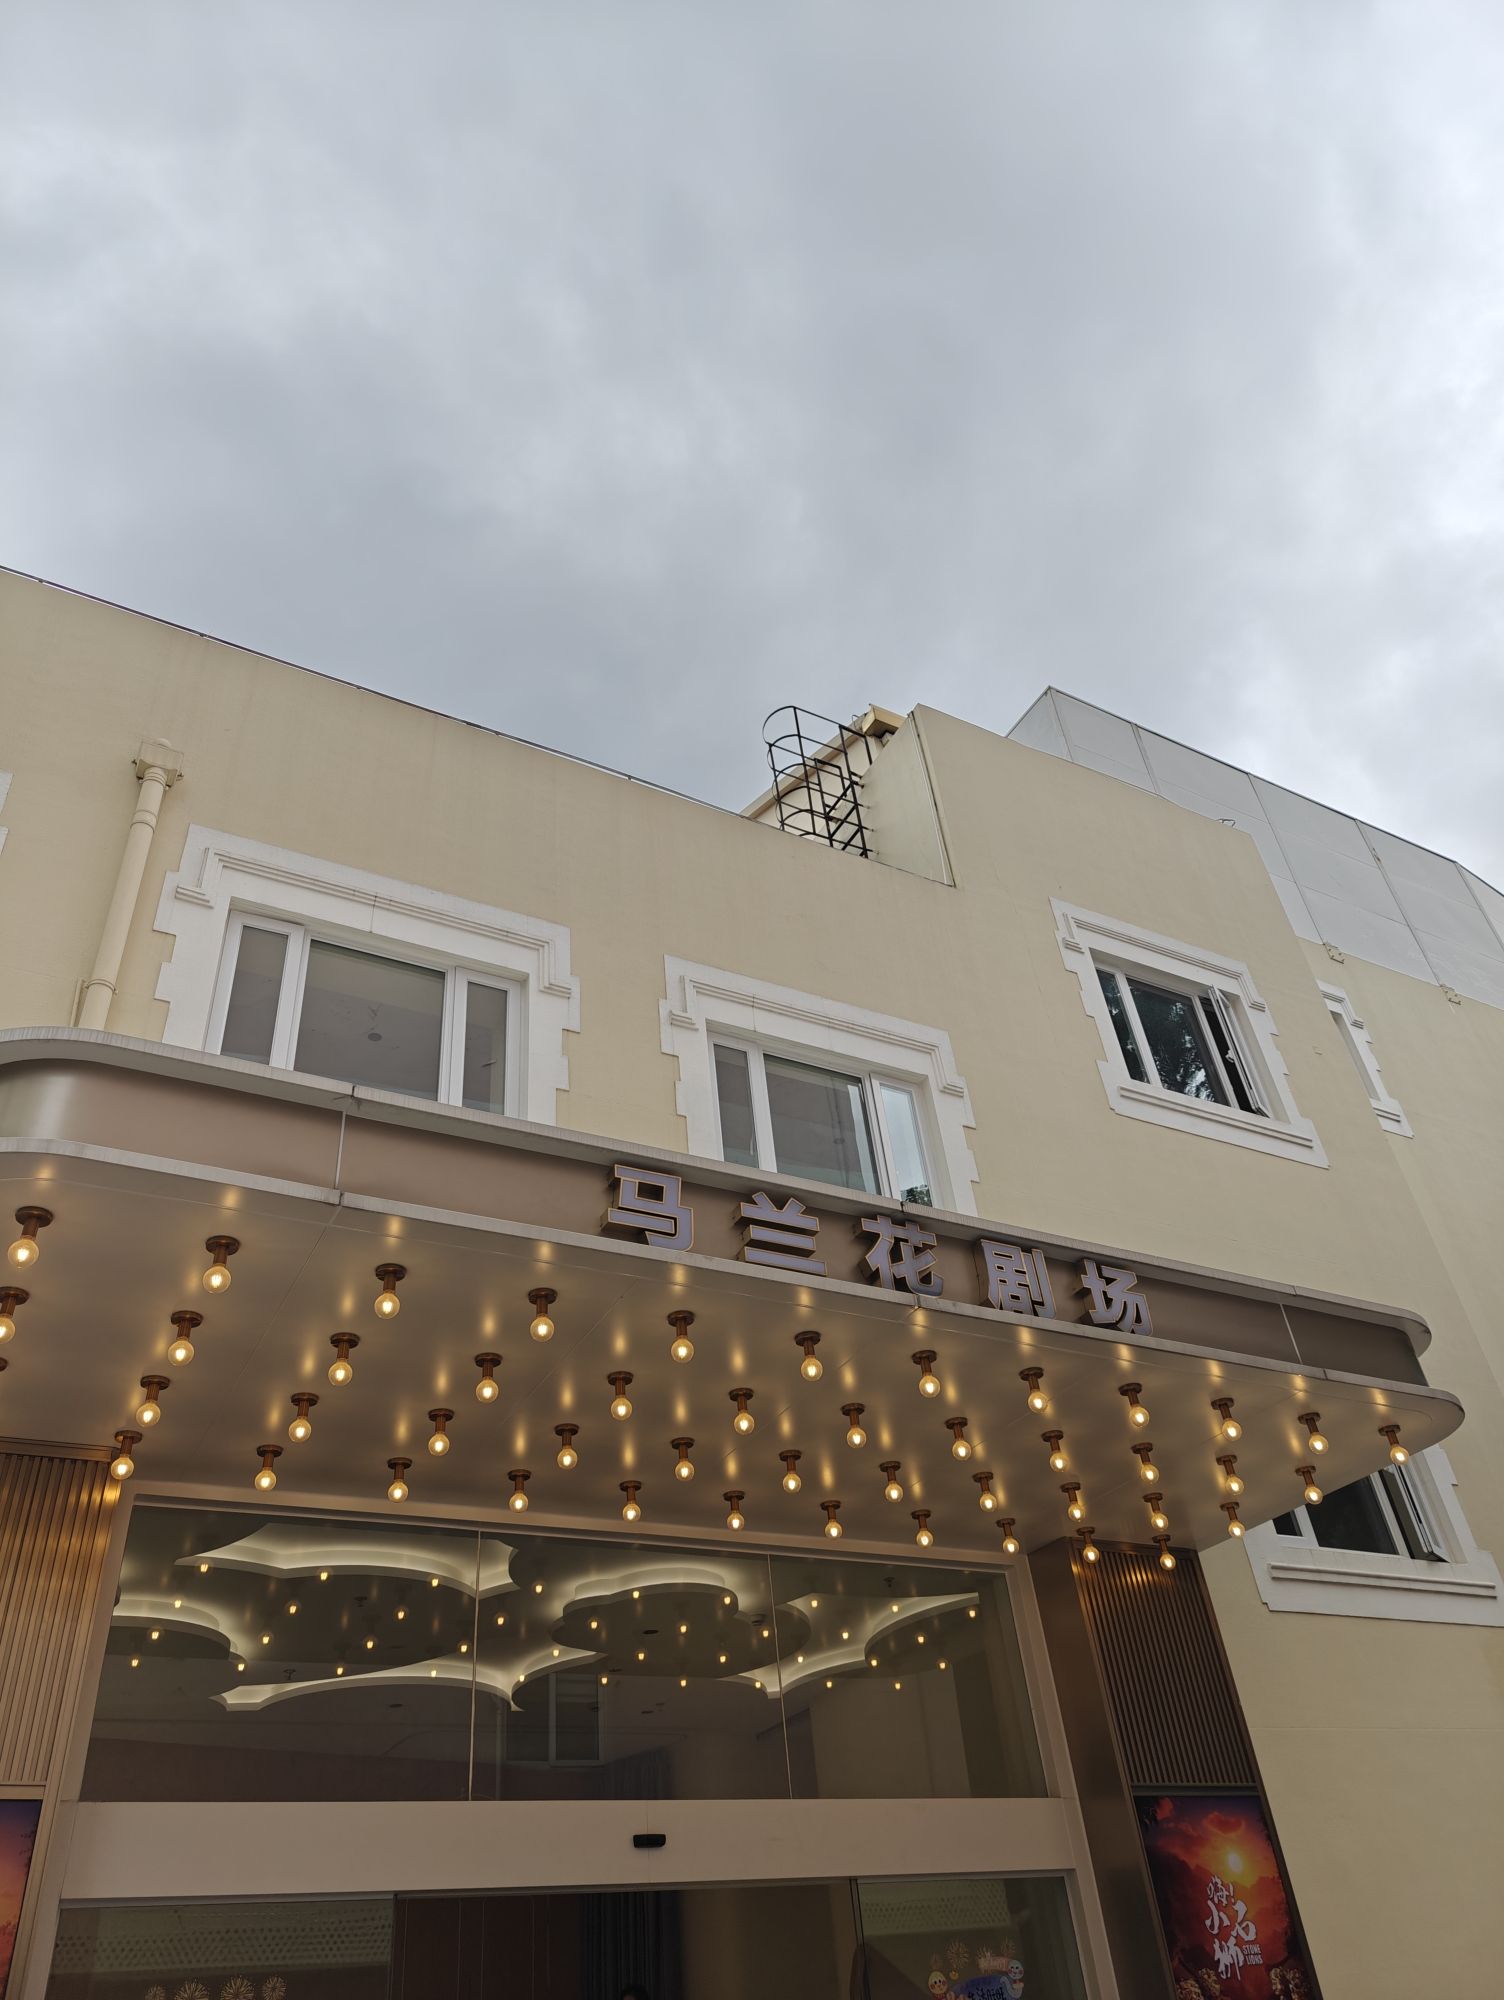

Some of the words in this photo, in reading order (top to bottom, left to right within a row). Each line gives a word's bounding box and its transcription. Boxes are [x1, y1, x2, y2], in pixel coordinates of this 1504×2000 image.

[602, 1164, 1154, 1336] 马兰花剧场
